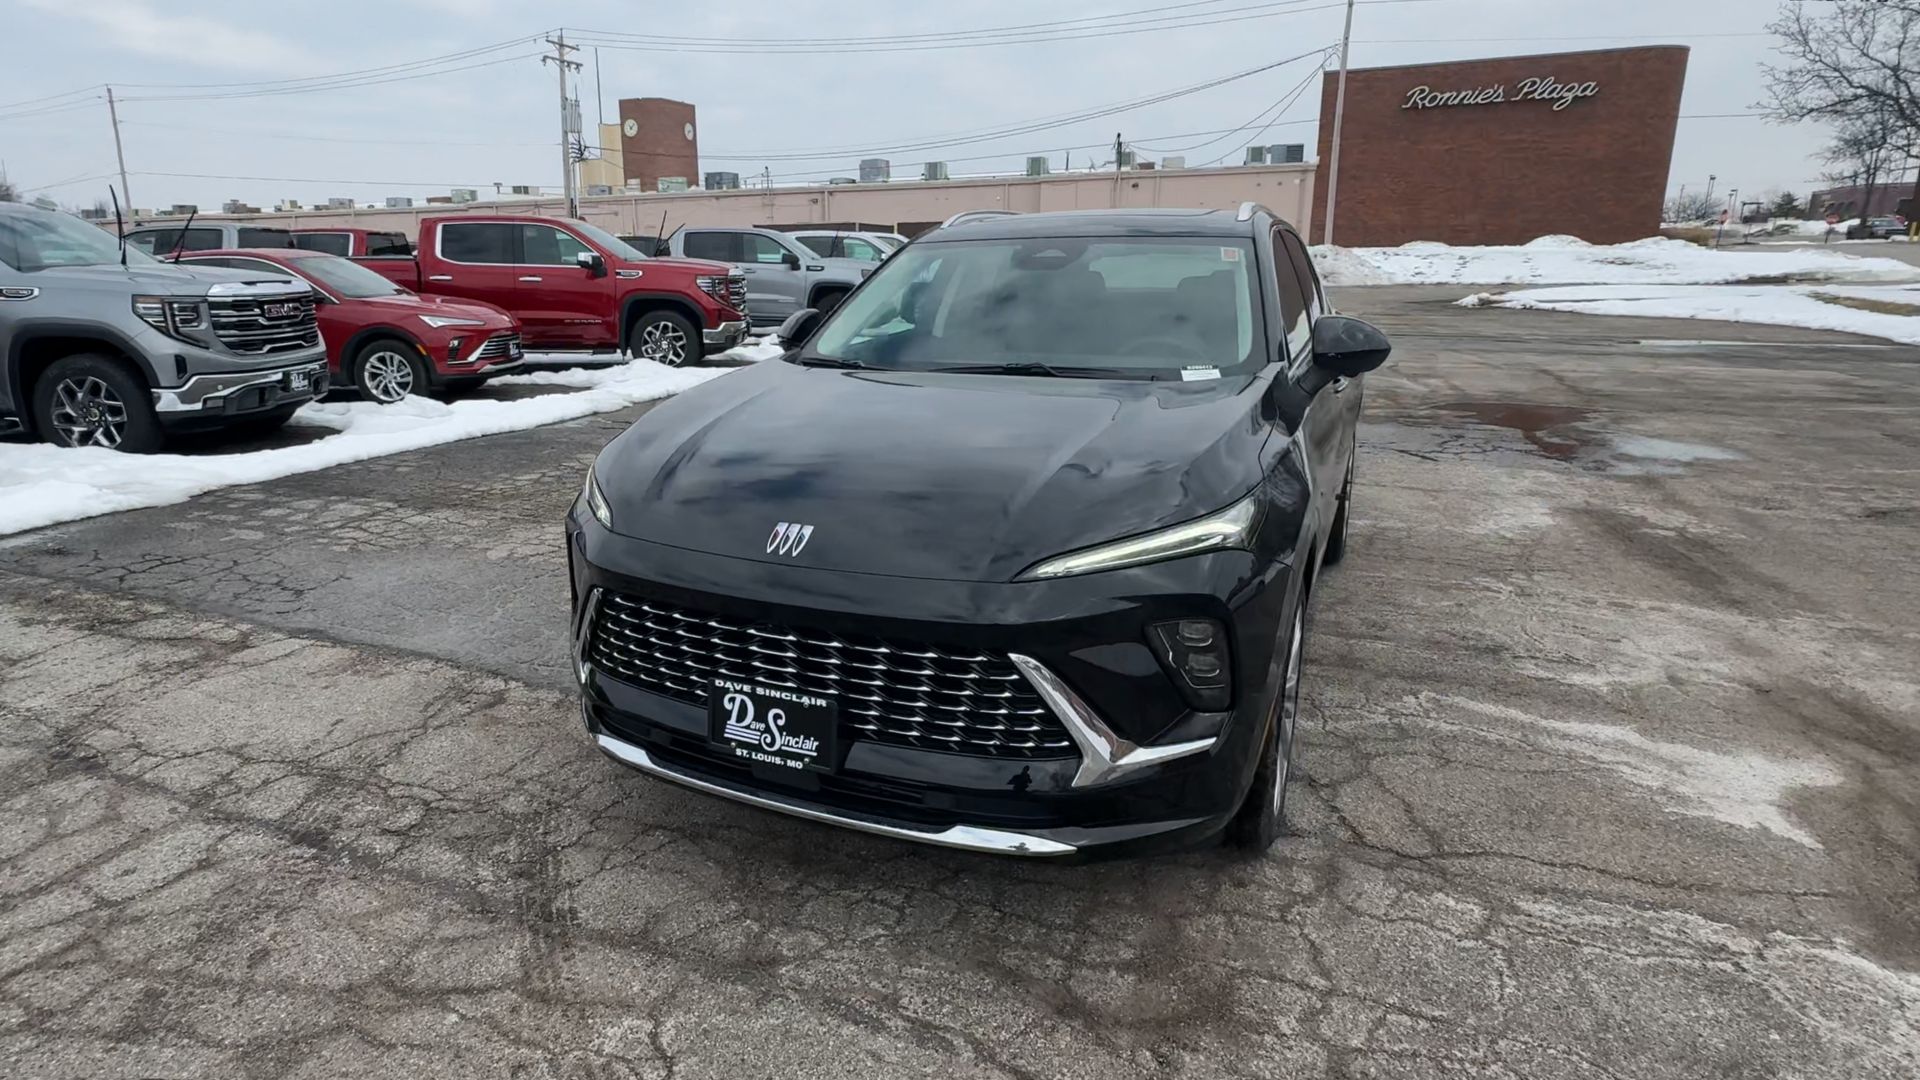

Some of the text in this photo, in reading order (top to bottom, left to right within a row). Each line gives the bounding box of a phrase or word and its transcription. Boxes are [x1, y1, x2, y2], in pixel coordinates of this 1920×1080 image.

[1401, 76, 1599, 111] Ronnie's Plaza
[715, 679, 827, 707] DAVE SINCLAIR
[723, 693, 819, 751] Dave Sinclair
[735, 748, 803, 769] ST. LOUIS, MO
